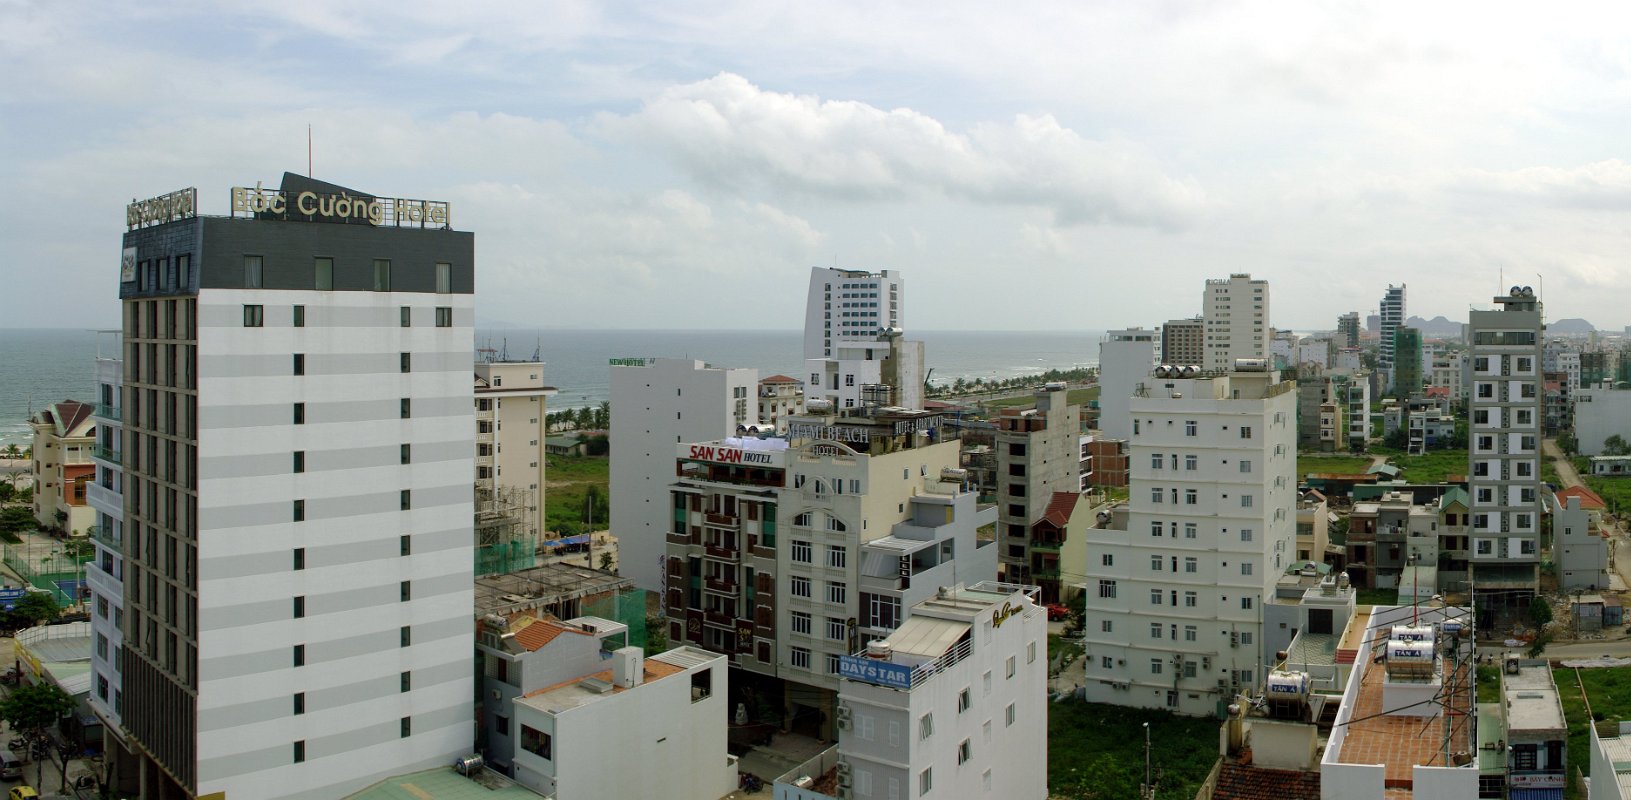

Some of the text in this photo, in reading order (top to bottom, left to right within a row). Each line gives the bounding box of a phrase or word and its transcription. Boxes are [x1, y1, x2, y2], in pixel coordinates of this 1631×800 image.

[233, 181, 451, 226] Bắc Cường Hotel
[787, 424, 869, 444] MIAMI BEACH
[690, 445, 772, 464] SAN SAN HOTEL
[812, 446, 839, 457] HOTEL
[840, 661, 906, 683] DAYSTAR
